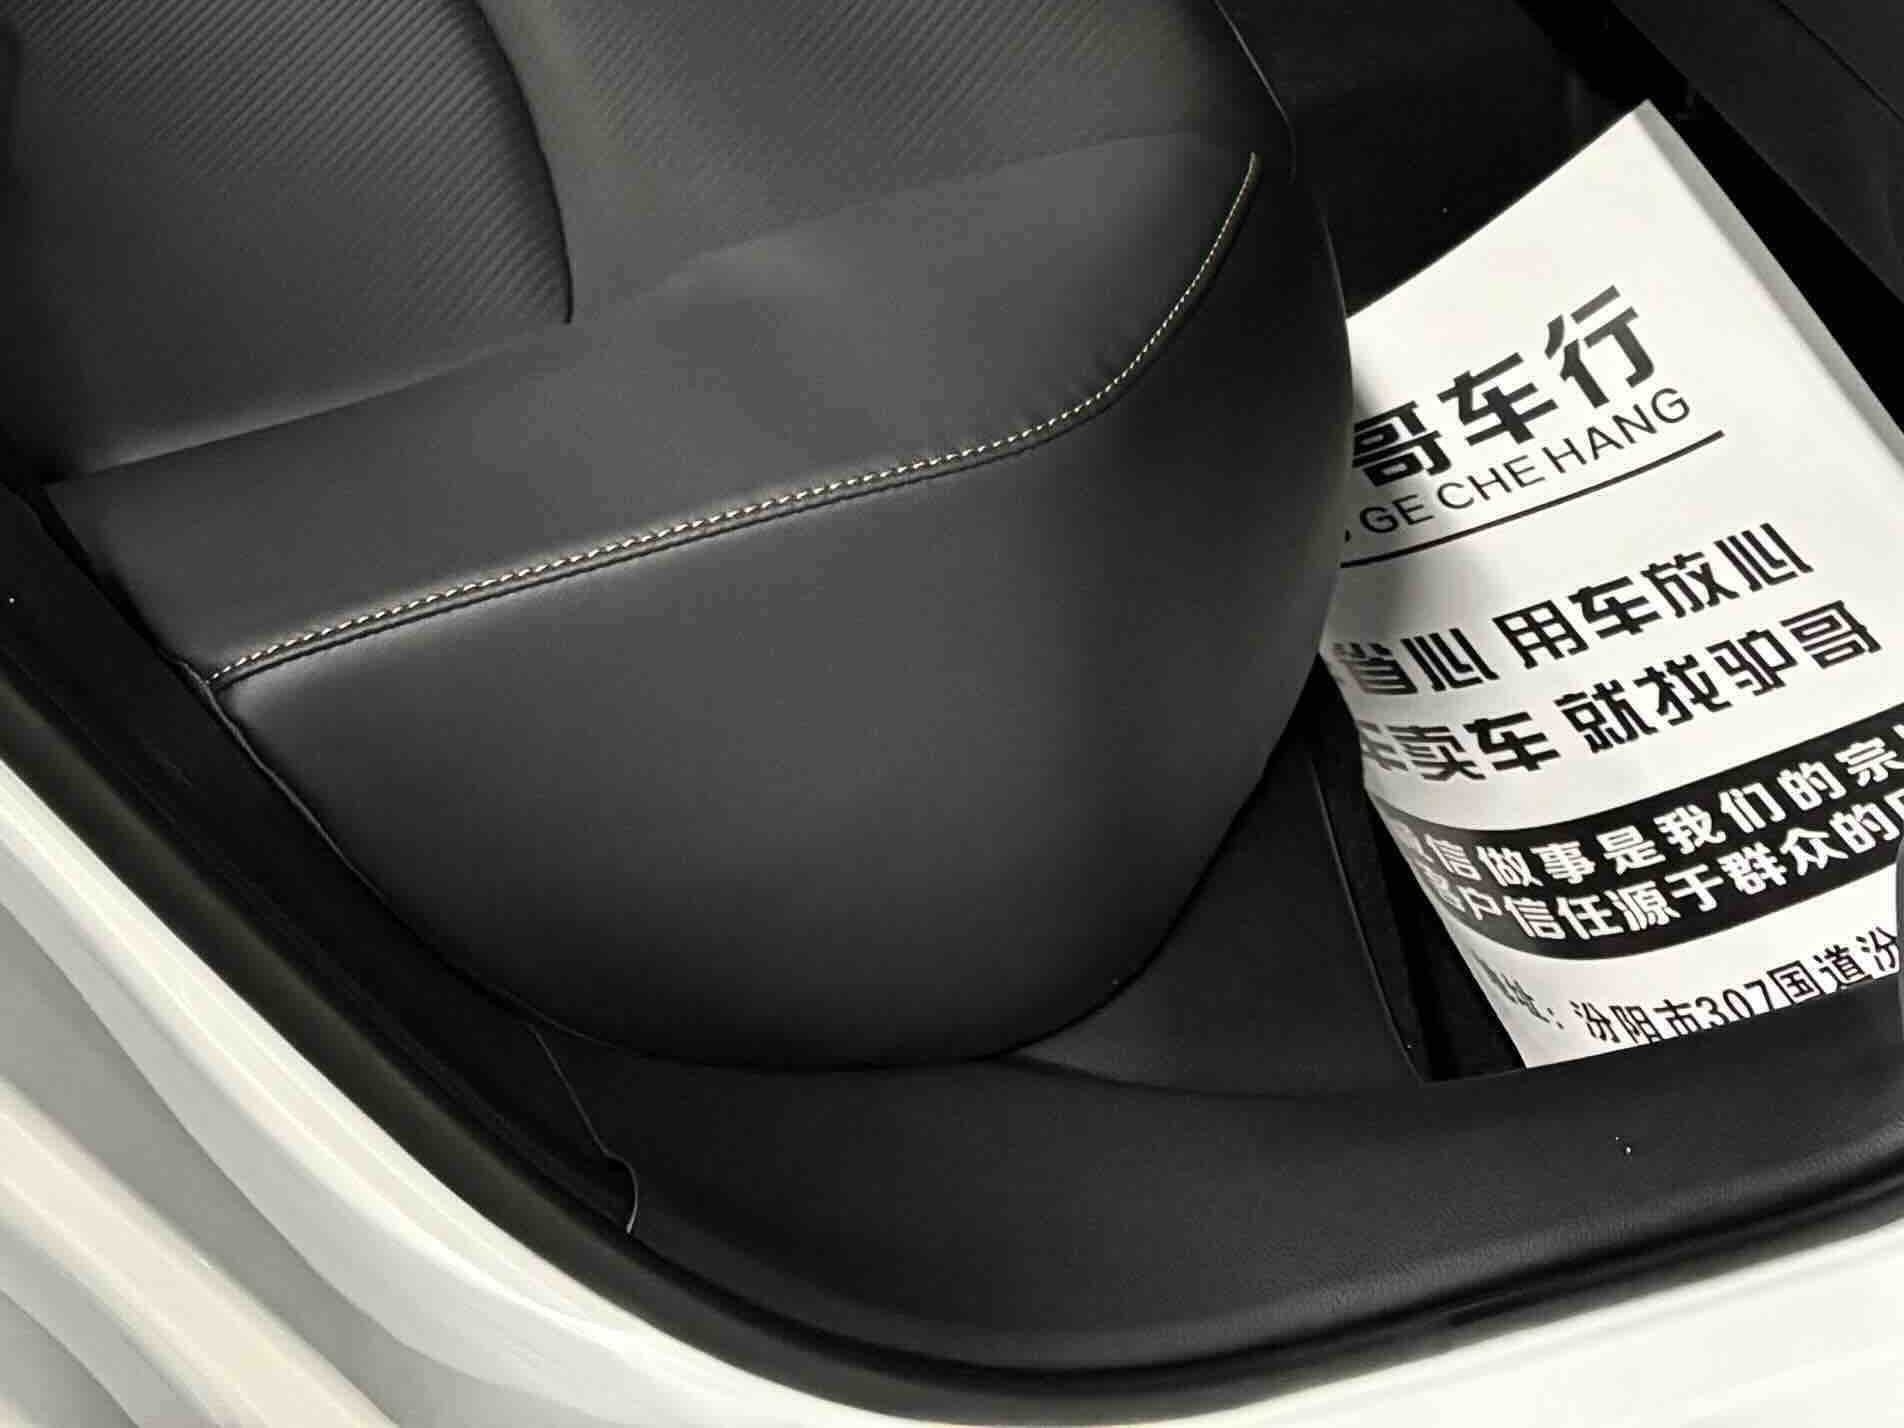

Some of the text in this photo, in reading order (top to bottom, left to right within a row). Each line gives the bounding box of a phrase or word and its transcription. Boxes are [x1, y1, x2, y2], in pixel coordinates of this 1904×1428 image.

[1359, 387, 1691, 535] GE CHE HANG
[1492, 522, 1815, 670] 用车放心
[1553, 599, 1883, 754] 就找驴哥
